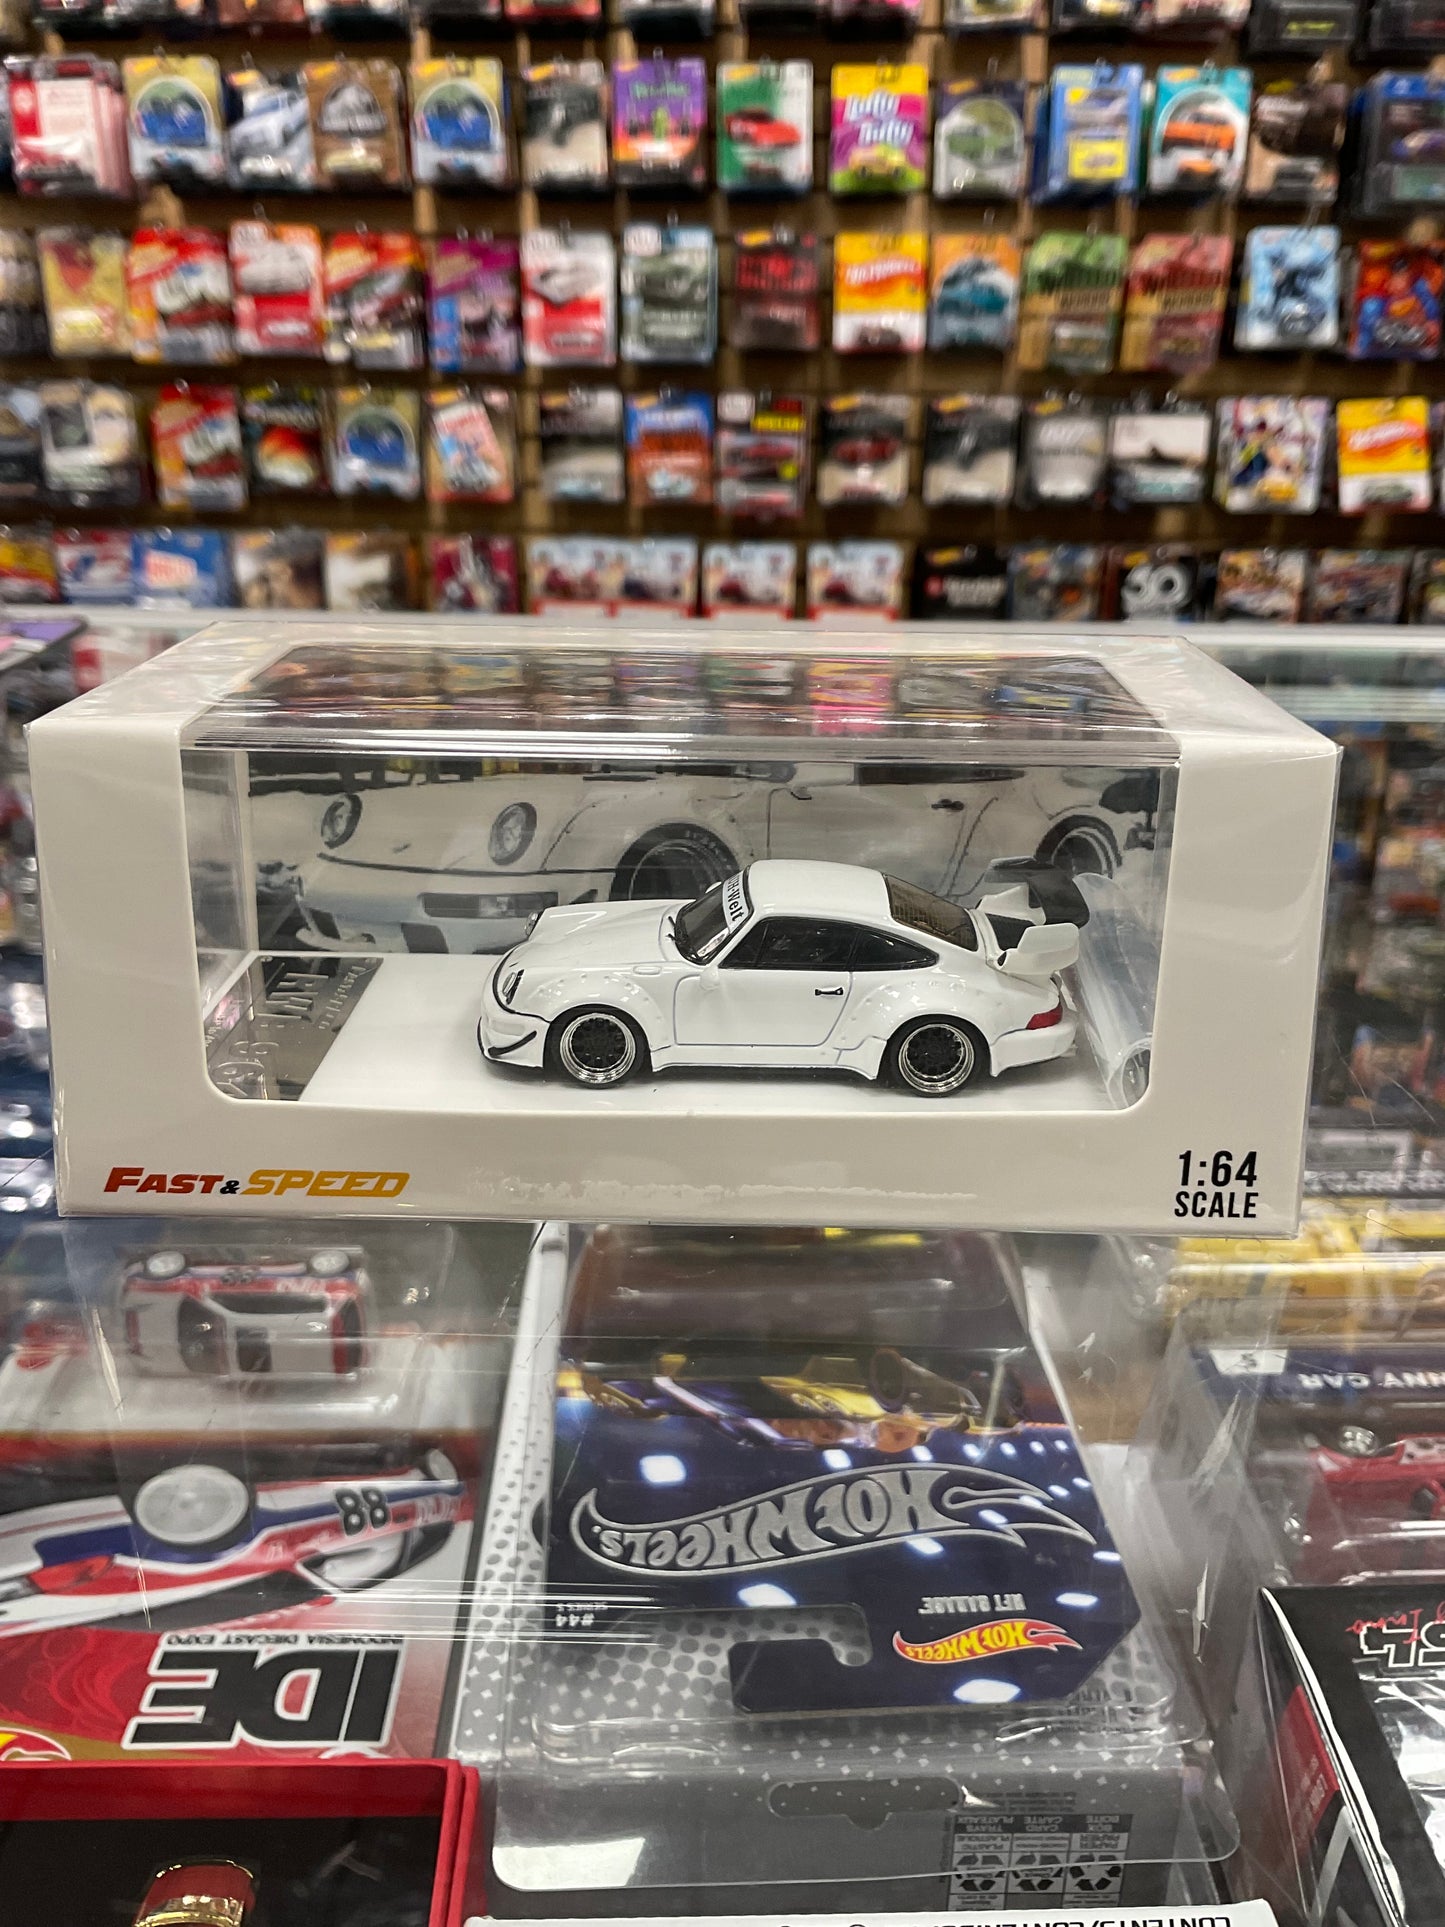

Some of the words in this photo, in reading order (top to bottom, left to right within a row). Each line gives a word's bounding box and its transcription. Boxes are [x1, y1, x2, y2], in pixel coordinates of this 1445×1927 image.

[1178, 1150, 1258, 1187] 1:64
[1174, 1191, 1259, 1218] SCALE
[335, 1488, 391, 1536] 88
[166, 1634, 215, 1646] EXPO
[222, 1634, 298, 1646] DIECAST
[130, 1649, 400, 1744] IDE
